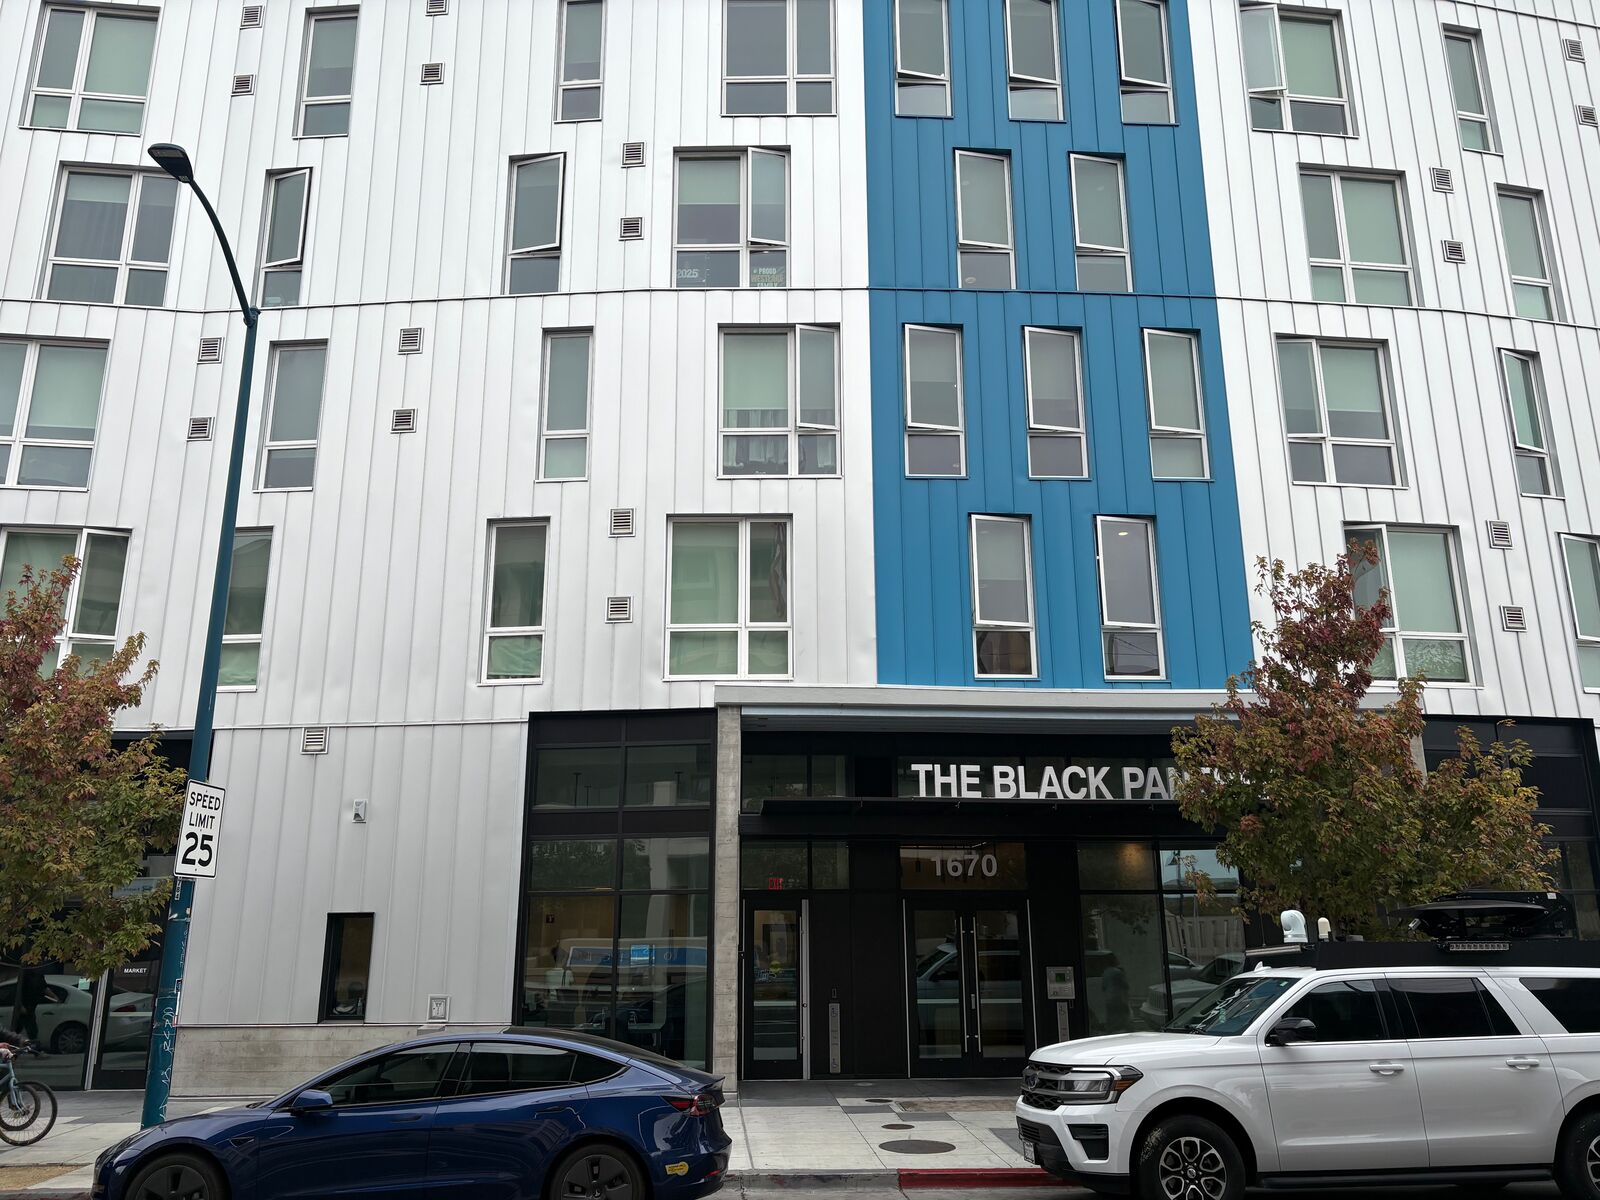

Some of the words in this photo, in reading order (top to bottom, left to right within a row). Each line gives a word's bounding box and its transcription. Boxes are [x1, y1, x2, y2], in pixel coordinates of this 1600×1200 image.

[677, 268, 699, 279] 2025
[911, 763, 982, 798] THE
[993, 765, 1114, 800] BLACK
[189, 791, 221, 811] SPEED
[188, 811, 216, 830] LIMIT
[181, 831, 214, 867] 25
[930, 853, 998, 877] 1670
[768, 877, 785, 890] EXIT
